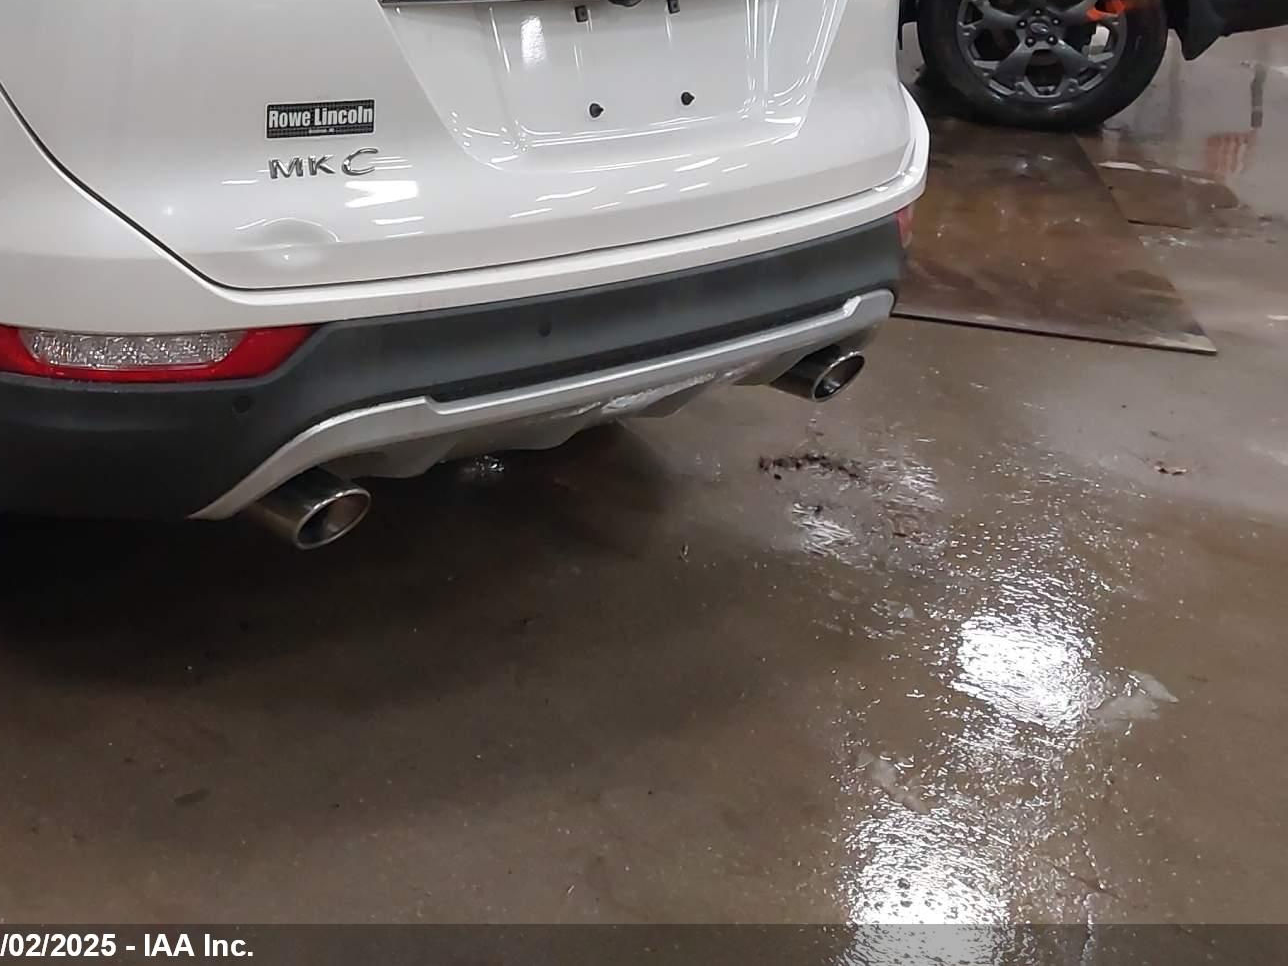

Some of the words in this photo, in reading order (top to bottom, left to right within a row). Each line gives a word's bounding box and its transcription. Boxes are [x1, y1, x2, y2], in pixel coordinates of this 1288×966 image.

[268, 109, 311, 128] Rowe
[314, 105, 373, 126] Lincoln
[268, 146, 379, 180] MKC
